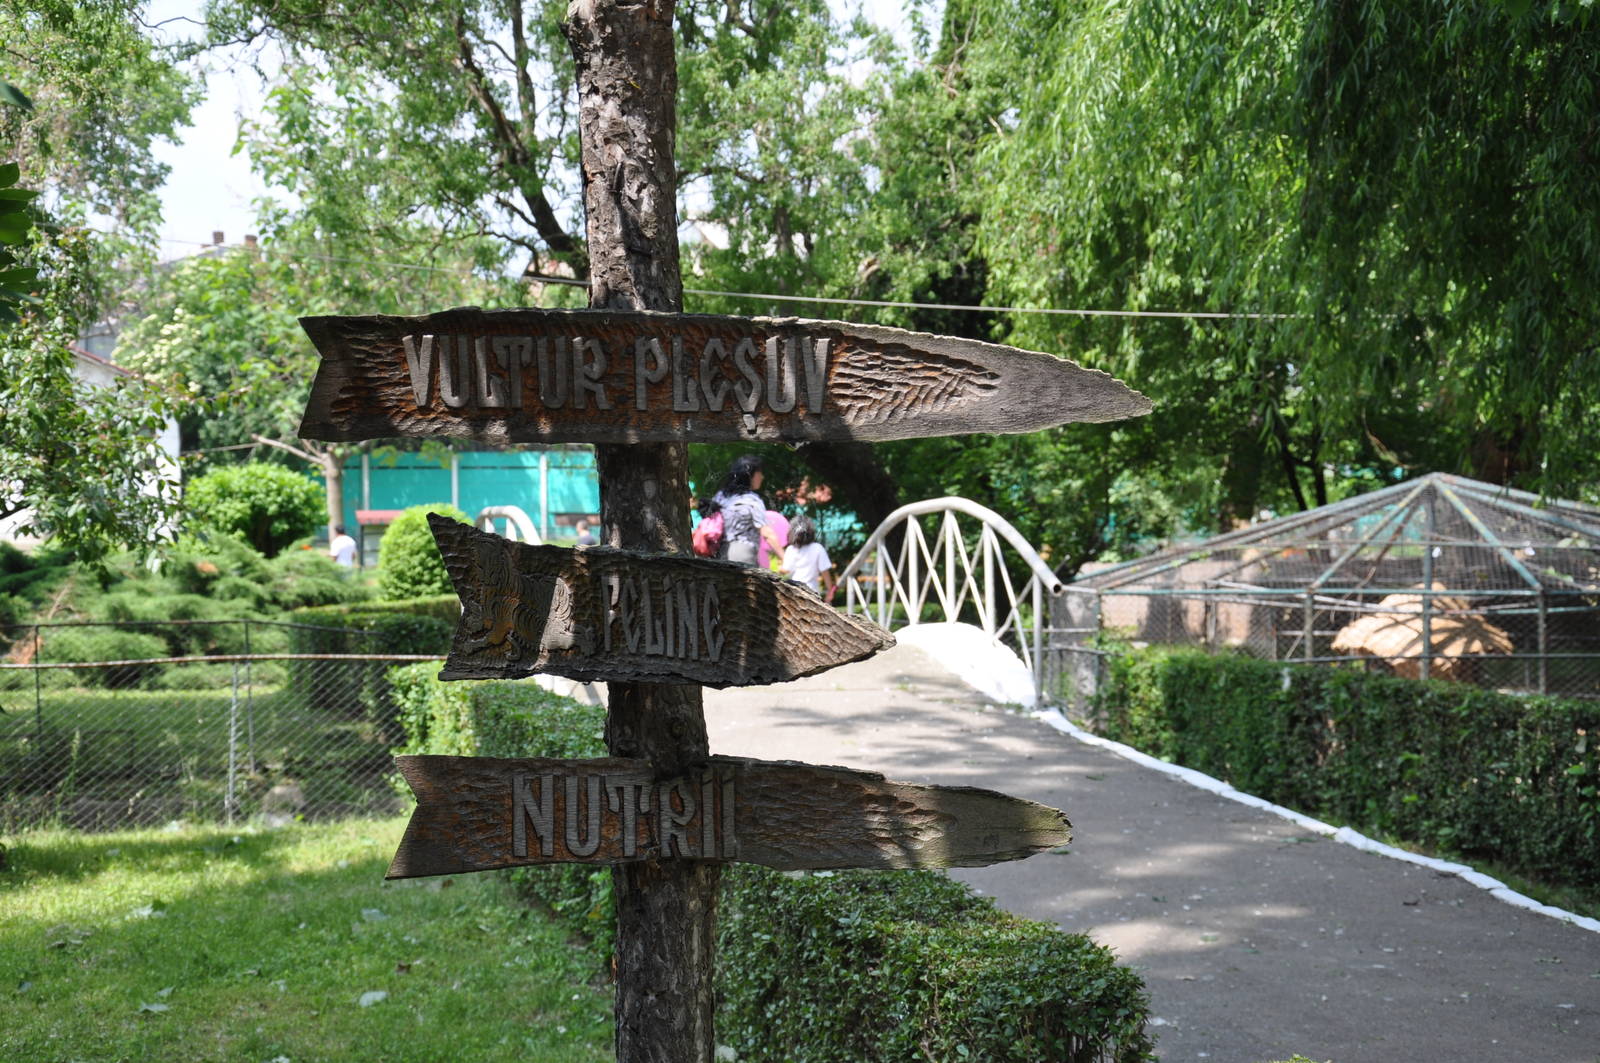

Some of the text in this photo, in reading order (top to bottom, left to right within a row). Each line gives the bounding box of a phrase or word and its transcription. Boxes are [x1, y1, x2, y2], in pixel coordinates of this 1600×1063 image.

[402, 333, 612, 409] VULTUR
[601, 572, 725, 663] FELINE
[512, 768, 738, 858] NUTRII
